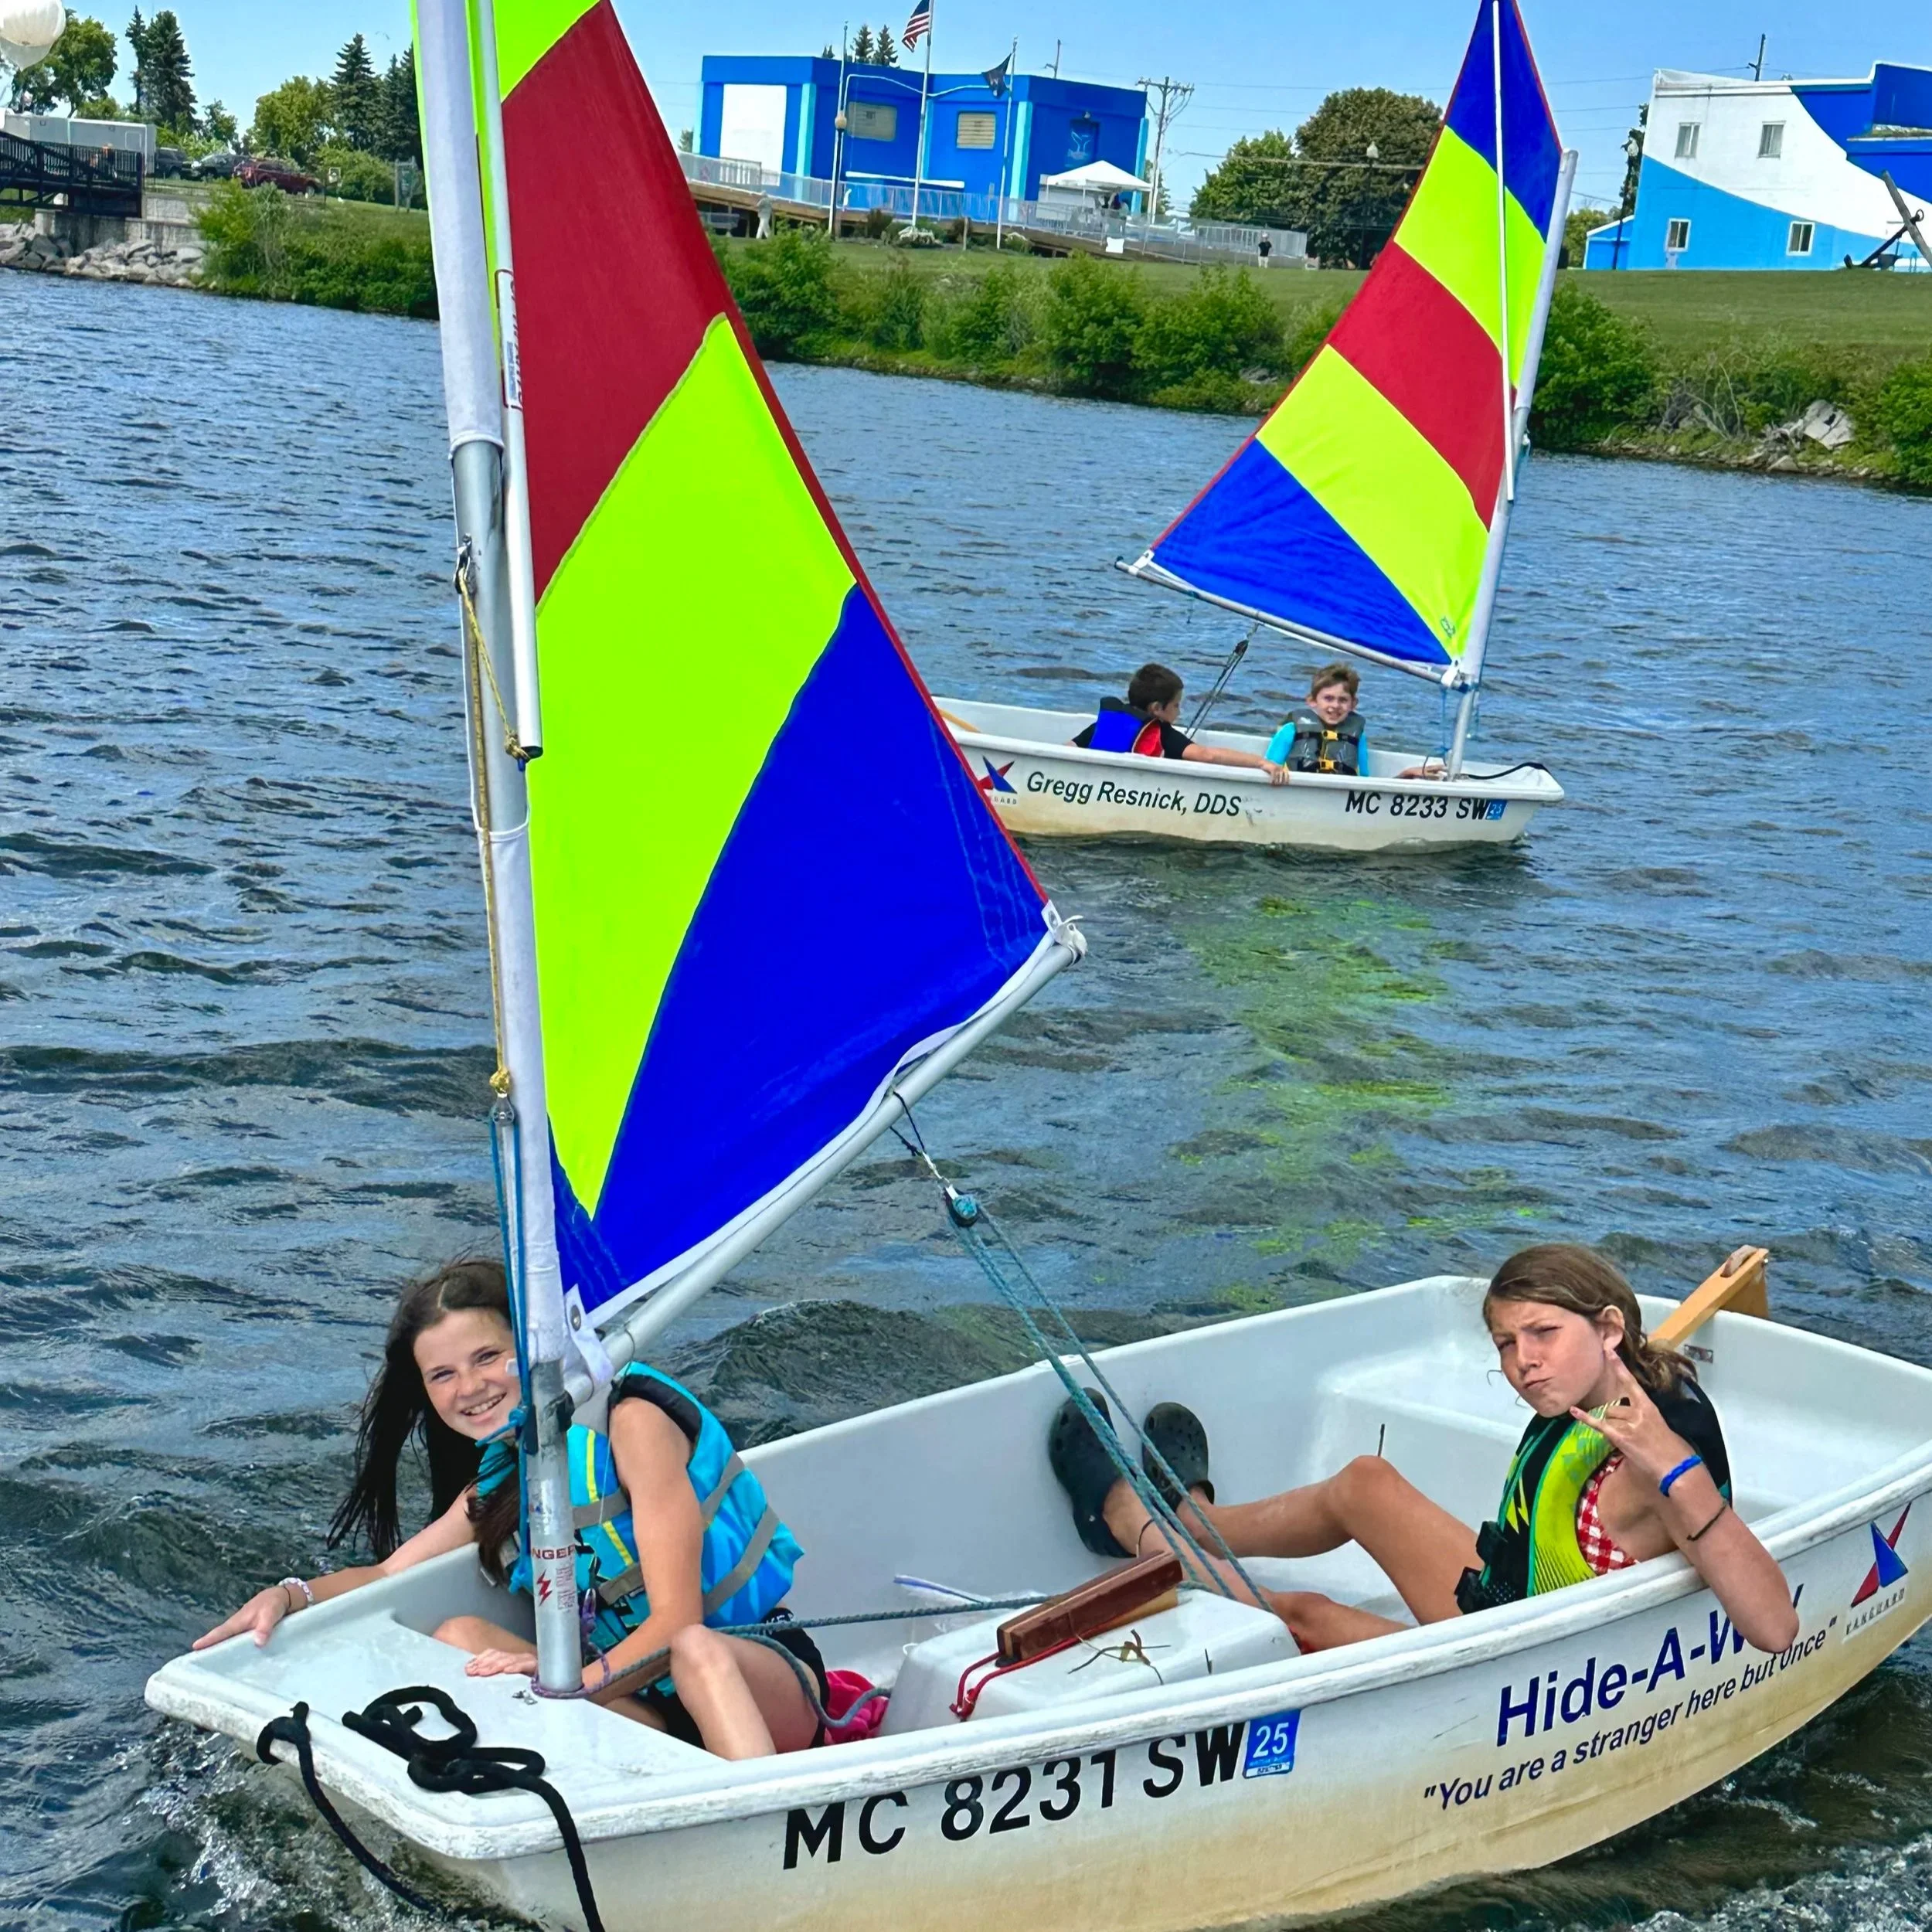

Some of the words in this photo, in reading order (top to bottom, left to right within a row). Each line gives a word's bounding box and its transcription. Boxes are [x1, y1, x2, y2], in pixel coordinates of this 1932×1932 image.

[1027, 770, 1093, 805] Gregg
[1097, 781, 1187, 816] Resnick,
[1193, 792, 1242, 817] DDS
[1345, 791, 1381, 815] MC
[1390, 794, 1449, 819] 8233
[1456, 798, 1490, 820] SW
[1253, 1722, 1289, 1759] 25
[1424, 1777, 1493, 1811] "You
[1498, 1757, 1544, 1791] are
[1551, 1749, 1566, 1773] a
[1573, 1701, 1683, 1764] stranger
[1685, 1677, 1736, 1719] here
[1740, 1653, 1777, 1692] but
[783, 1791, 909, 1870] MC
[940, 1750, 1117, 1842] 8231
[1142, 1721, 1246, 1798] SW
